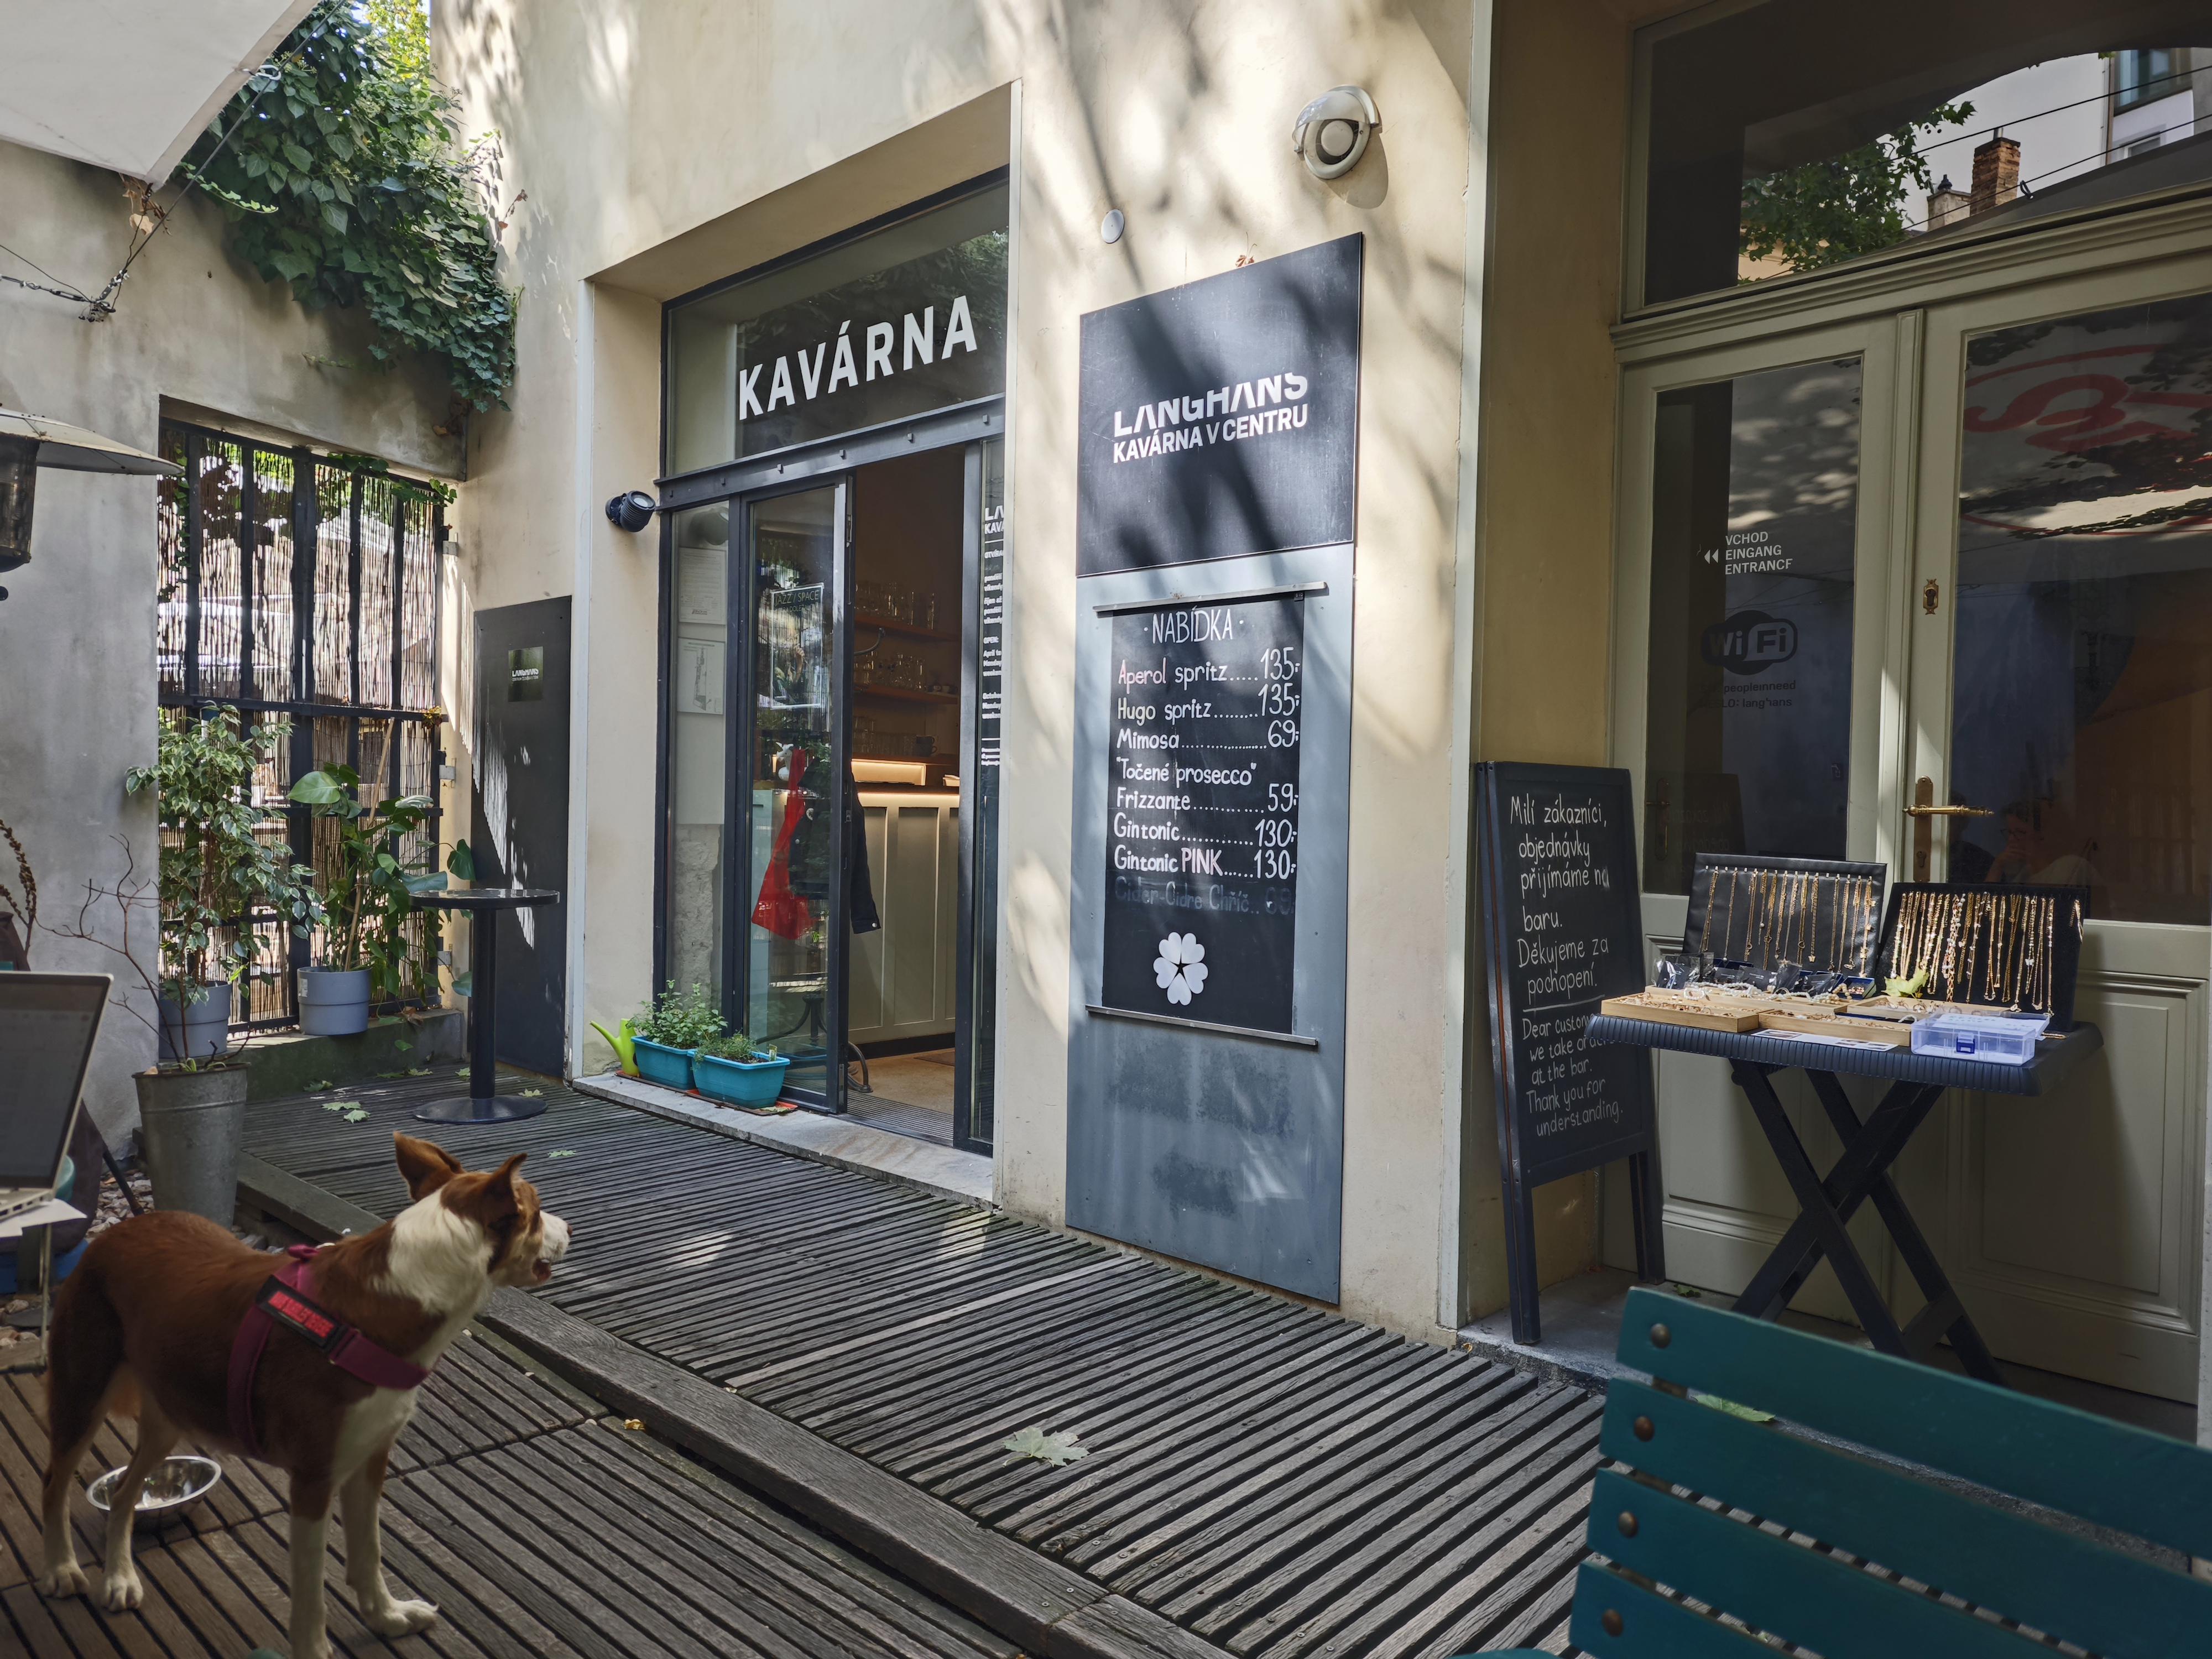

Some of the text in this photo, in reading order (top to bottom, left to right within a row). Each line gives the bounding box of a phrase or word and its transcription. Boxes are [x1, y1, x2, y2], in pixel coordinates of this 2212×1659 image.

[739, 295, 977, 420] KAVÁRNA
[1114, 372, 1308, 437] LANGHANS
[1113, 404, 1308, 463] KAVÁRNA V CENTRU
[1725, 531, 1768, 545] VCHOD
[1725, 545, 1782, 560] EINGANG
[797, 590, 820, 602] SPACE
[1152, 606, 1233, 644] NABÍDKA
[1118, 658, 1166, 693] Aperol
[1175, 661, 1227, 690] spritz
[1118, 698, 1155, 726] Hugo
[1165, 700, 1212, 724] spritz
[1117, 728, 1180, 749] Mimosa
[1117, 787, 1190, 810] Frizzante
[1510, 793, 1606, 827] Milí zákazníci,
[1114, 812, 1180, 841] Gintonic
[1114, 845, 1178, 872] Gintonic
[1181, 848, 1223, 876] PINK
[1519, 830, 1590, 867] objednávky
[1521, 862, 1610, 899] přijímáme na
[1523, 905, 1562, 932] baru.
[1517, 935, 1609, 973] Děkujeme za
[1527, 962, 1597, 1004] pochopení.
[1522, 1018, 1551, 1040] Dear
[1530, 1045, 1545, 1062] we
[1549, 1037, 1574, 1058] take
[1531, 1058, 1593, 1086] at the bar.
[1526, 1079, 1606, 1114] Thank you for
[1536, 1100, 1624, 1137] understanding.
